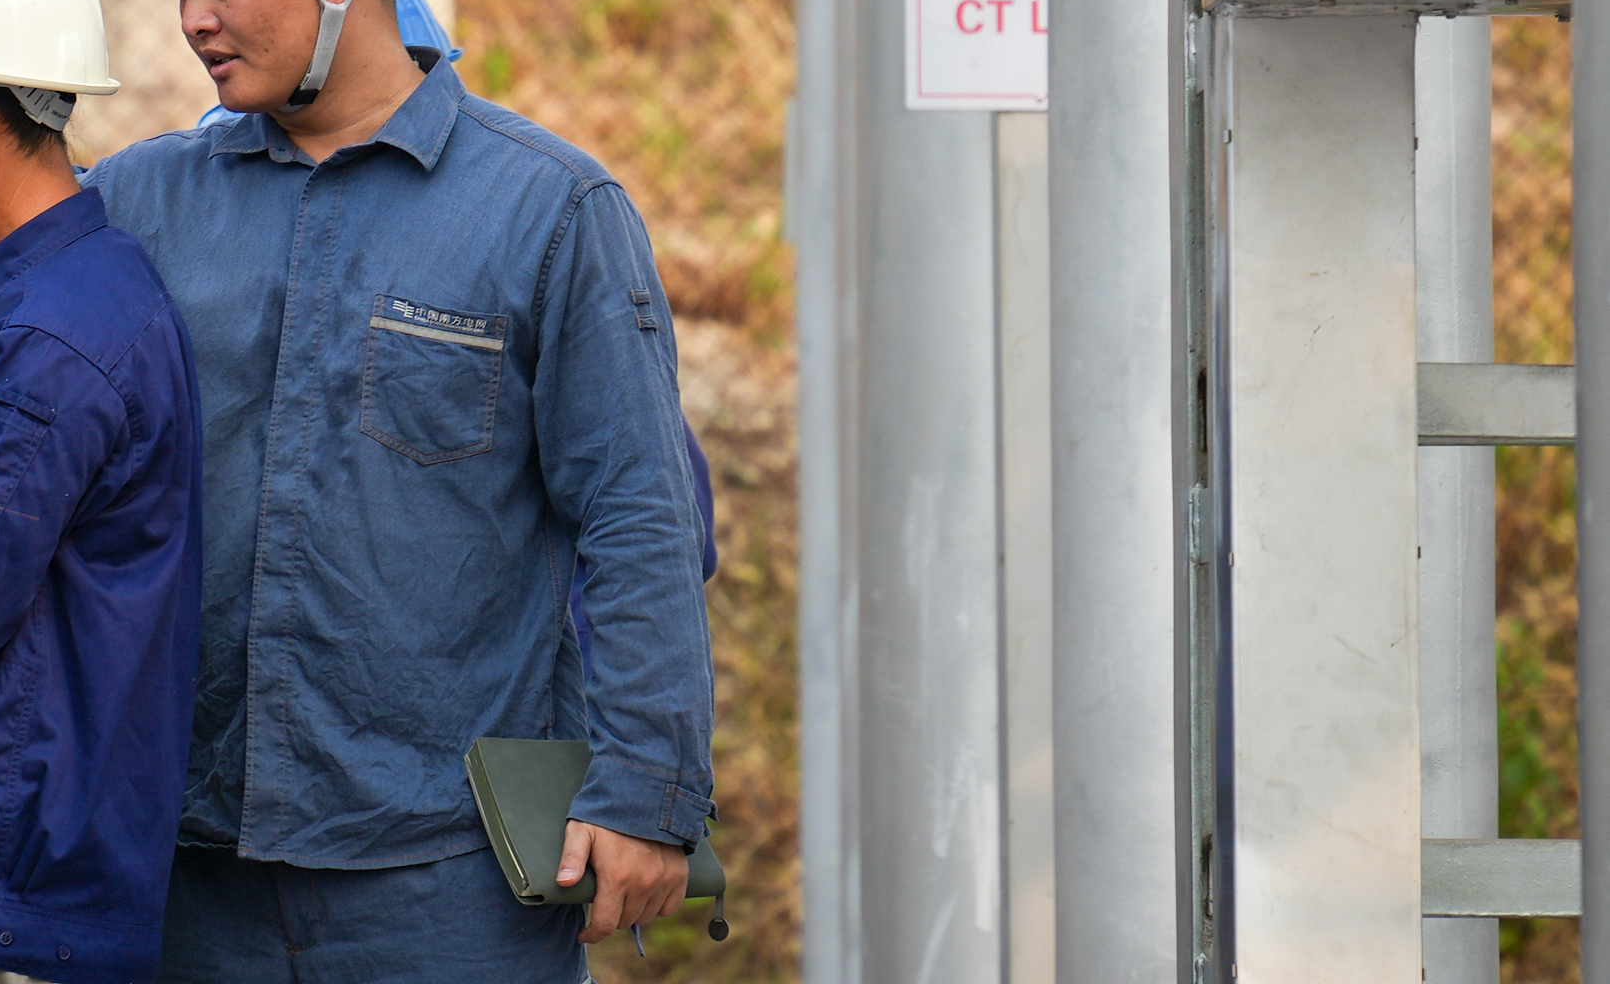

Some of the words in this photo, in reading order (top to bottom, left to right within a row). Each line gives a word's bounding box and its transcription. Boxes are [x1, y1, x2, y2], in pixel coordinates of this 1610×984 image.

[1031, 0, 1048, 34] L
[414, 306, 488, 329] 中国南方电网
